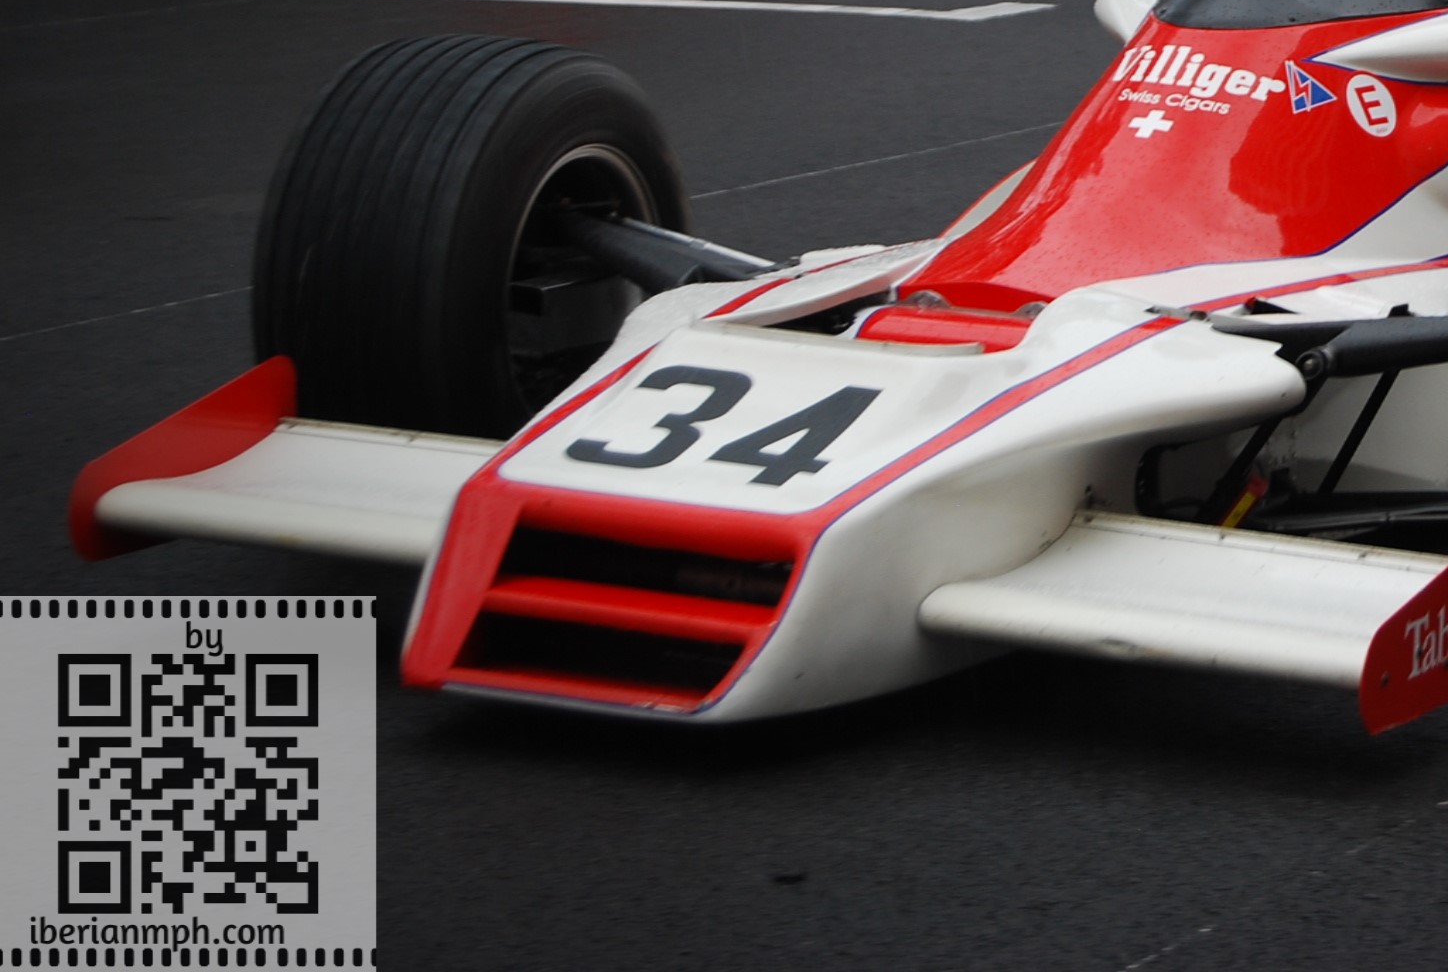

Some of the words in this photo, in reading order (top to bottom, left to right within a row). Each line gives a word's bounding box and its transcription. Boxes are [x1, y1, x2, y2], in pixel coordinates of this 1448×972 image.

[1110, 44, 1286, 102] Villiger
[1117, 88, 1161, 105] Swiss
[1354, 84, 1389, 126] E
[565, 364, 884, 487] 34
